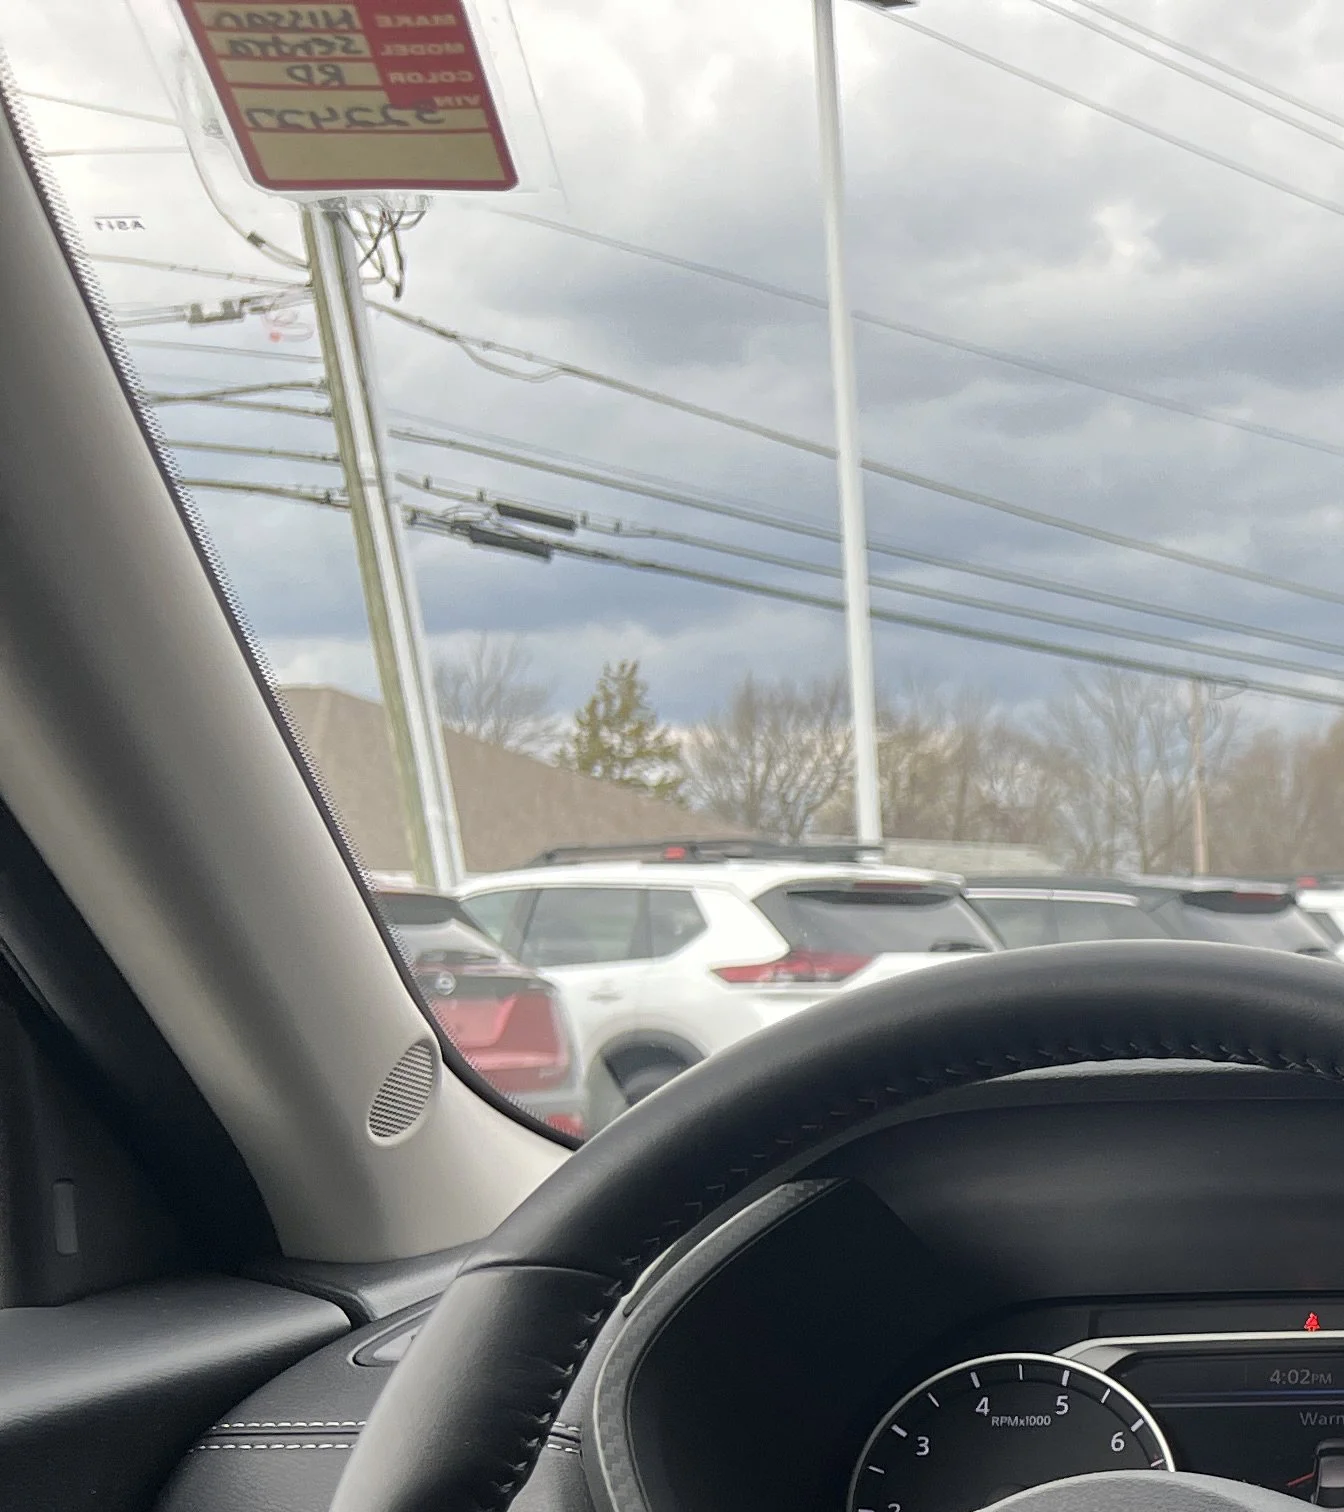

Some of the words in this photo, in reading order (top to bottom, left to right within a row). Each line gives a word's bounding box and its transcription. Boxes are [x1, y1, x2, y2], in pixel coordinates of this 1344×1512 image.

[975, 1396, 991, 1416] 4
[1055, 1395, 1069, 1415] 5
[916, 1436, 930, 1456] 3
[1110, 1431, 1125, 1452] 6
